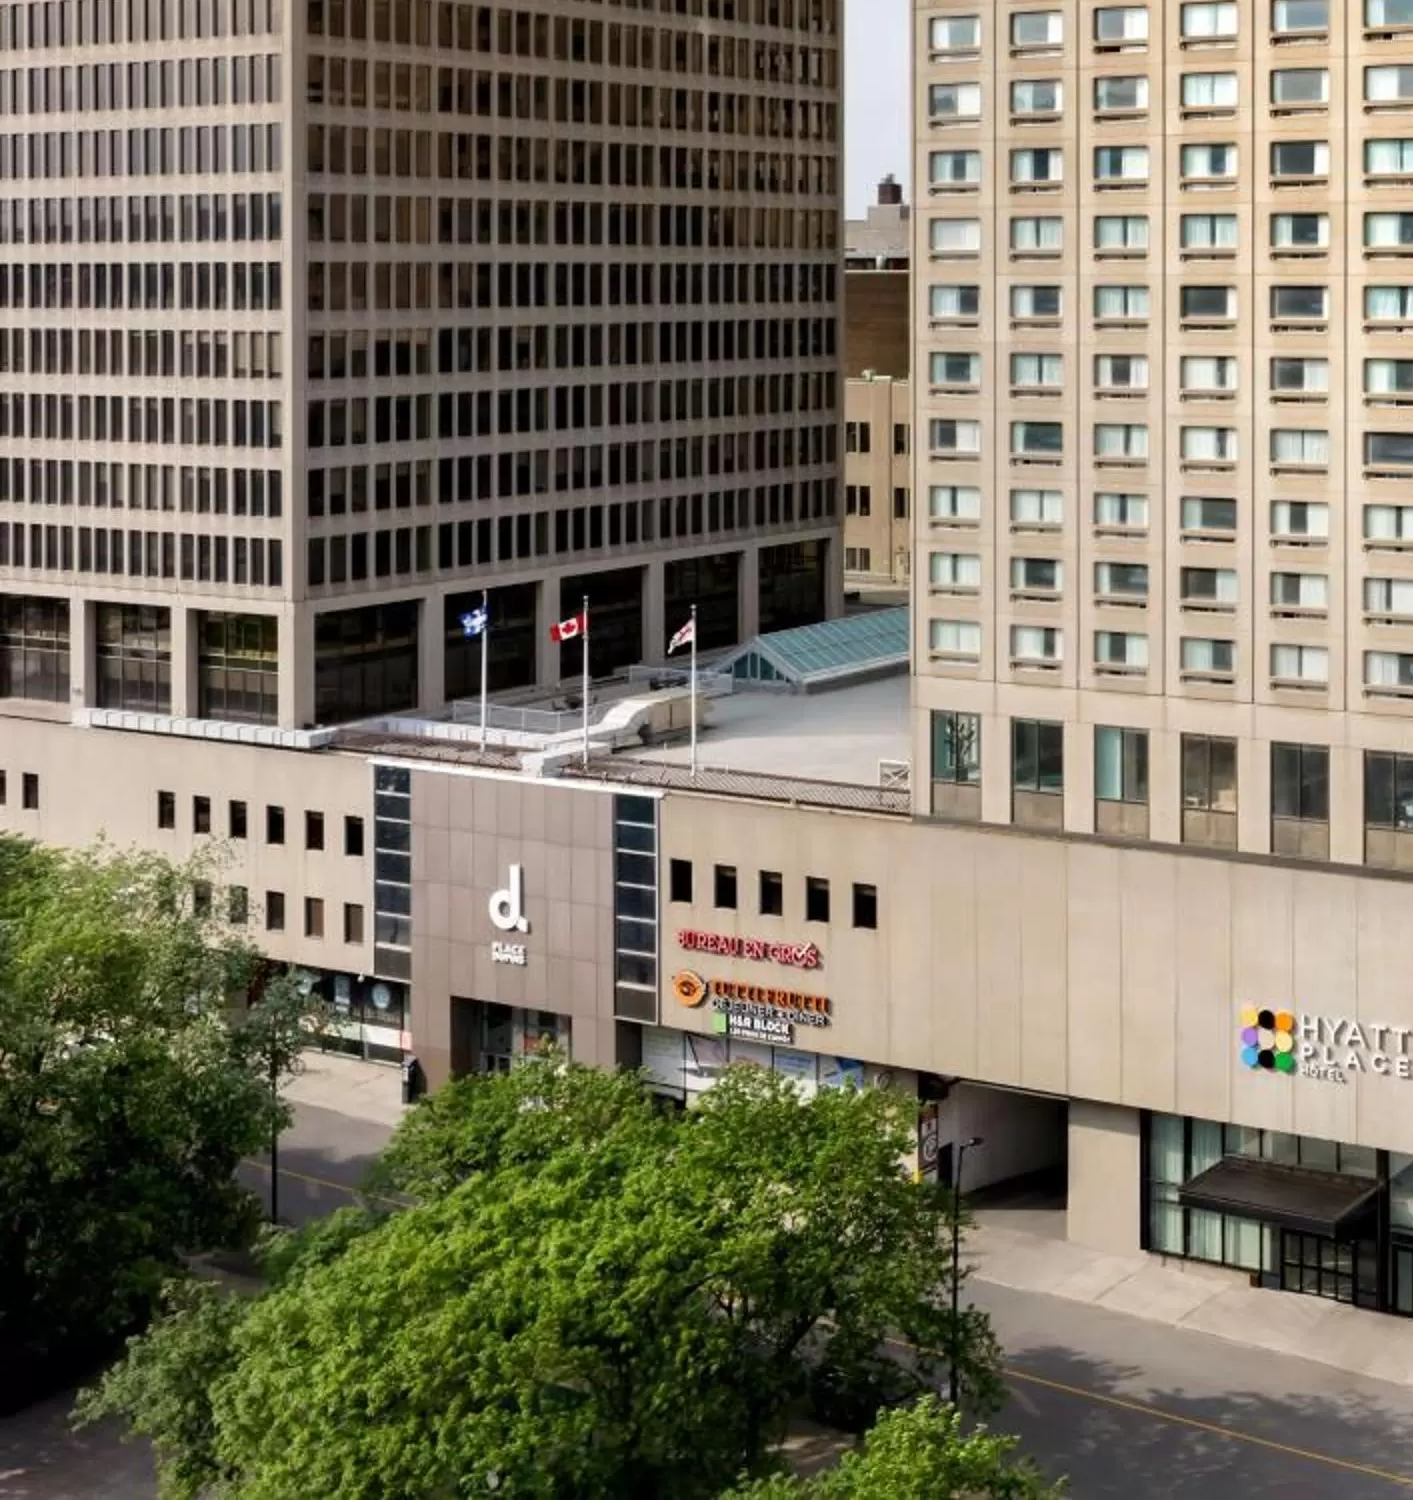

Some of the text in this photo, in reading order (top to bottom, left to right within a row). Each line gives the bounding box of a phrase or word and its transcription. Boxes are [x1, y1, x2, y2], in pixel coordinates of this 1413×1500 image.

[678, 930, 818, 968] BUREAU EN GROS
[754, 1018, 789, 1035] BLOCK
[1300, 1013, 1412, 1053] HYATT
[1300, 1043, 1411, 1078] PLACE
